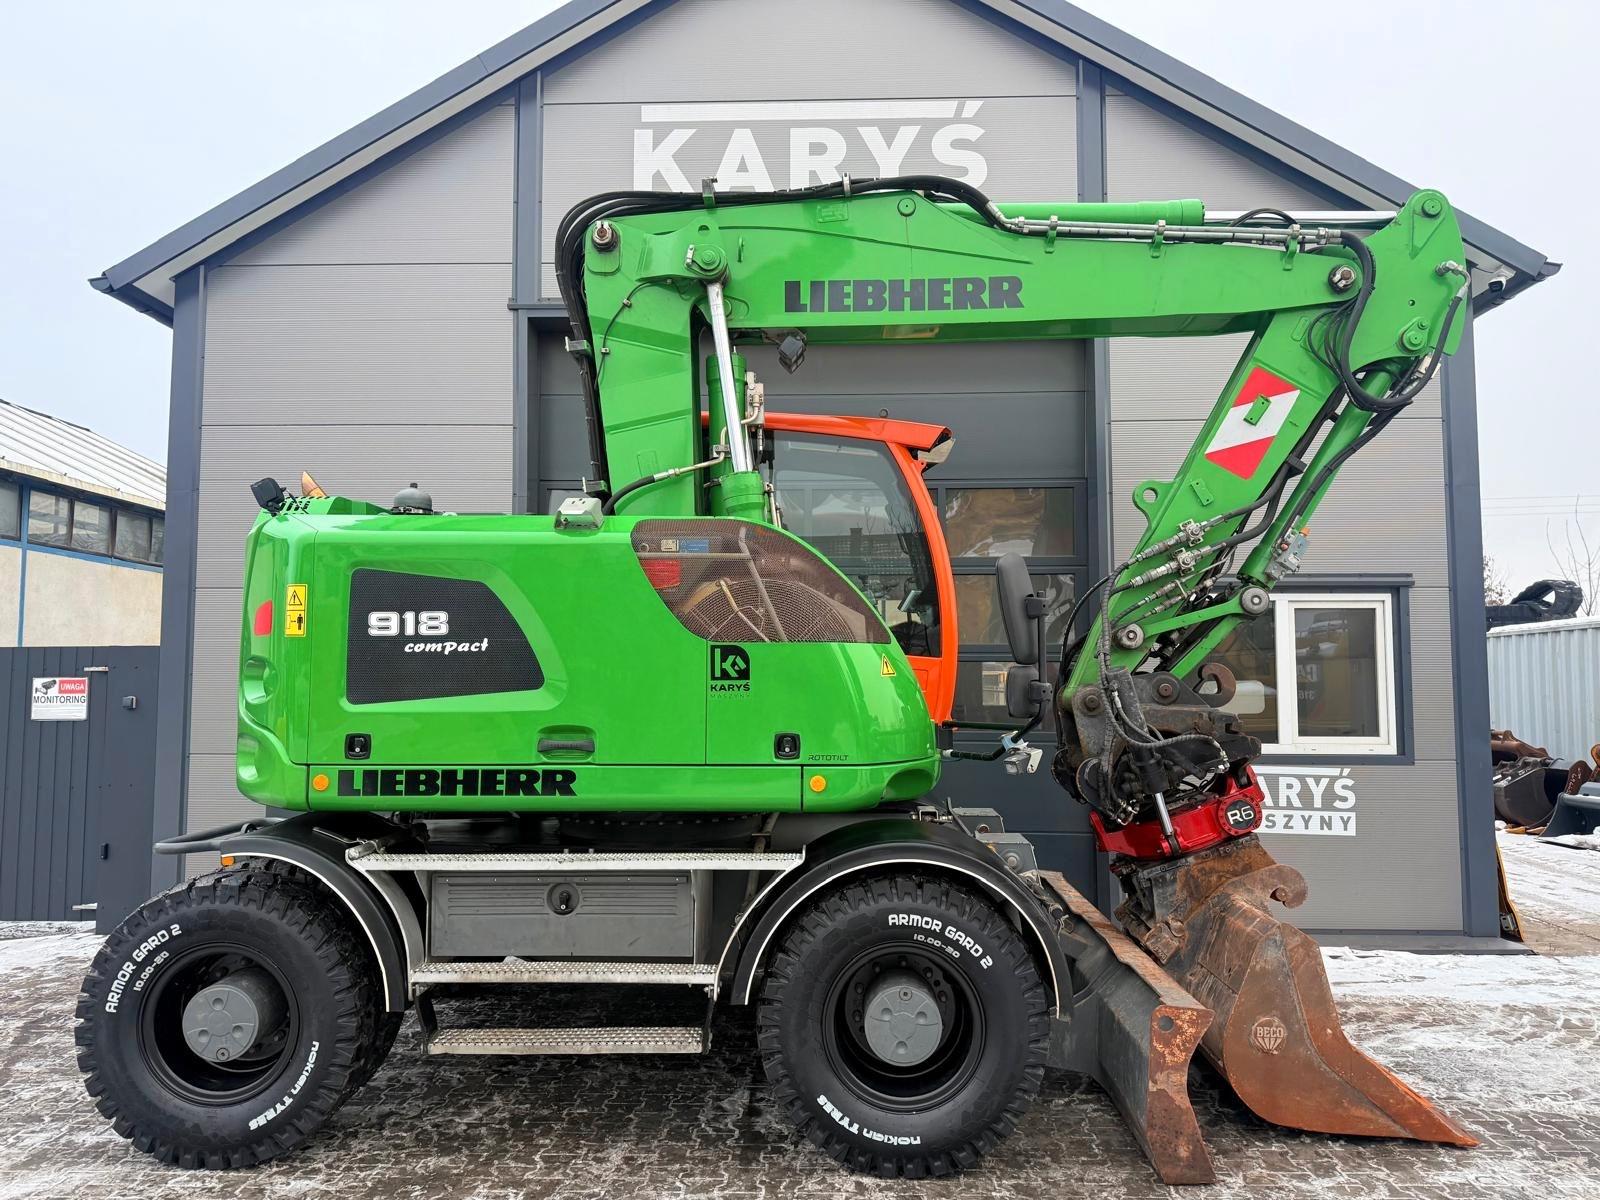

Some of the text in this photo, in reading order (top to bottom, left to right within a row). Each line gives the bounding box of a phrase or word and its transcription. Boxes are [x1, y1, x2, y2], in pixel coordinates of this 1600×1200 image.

[633, 100, 988, 193] KARYŚ
[784, 276, 1025, 313] LIEBHERR
[368, 610, 449, 636] 918
[404, 637, 489, 655] compact
[33, 695, 86, 704] MONITORING
[60, 683, 85, 691] UWAGA
[710, 682, 751, 692] KARYŚ
[337, 768, 577, 797] LIEBHERR
[1227, 805, 1254, 825] R6
[1264, 813, 1352, 832] SZYNY
[888, 913, 993, 969] ARMOR GARD 2
[913, 933, 960, 958] 10.00-20
[105, 923, 182, 1013] ARMOR GARD 2
[133, 950, 170, 992] 10.00-20
[1256, 1026, 1284, 1038] BECO
[248, 1095, 294, 1131] TYRES
[816, 1094, 860, 1135] TYRES
